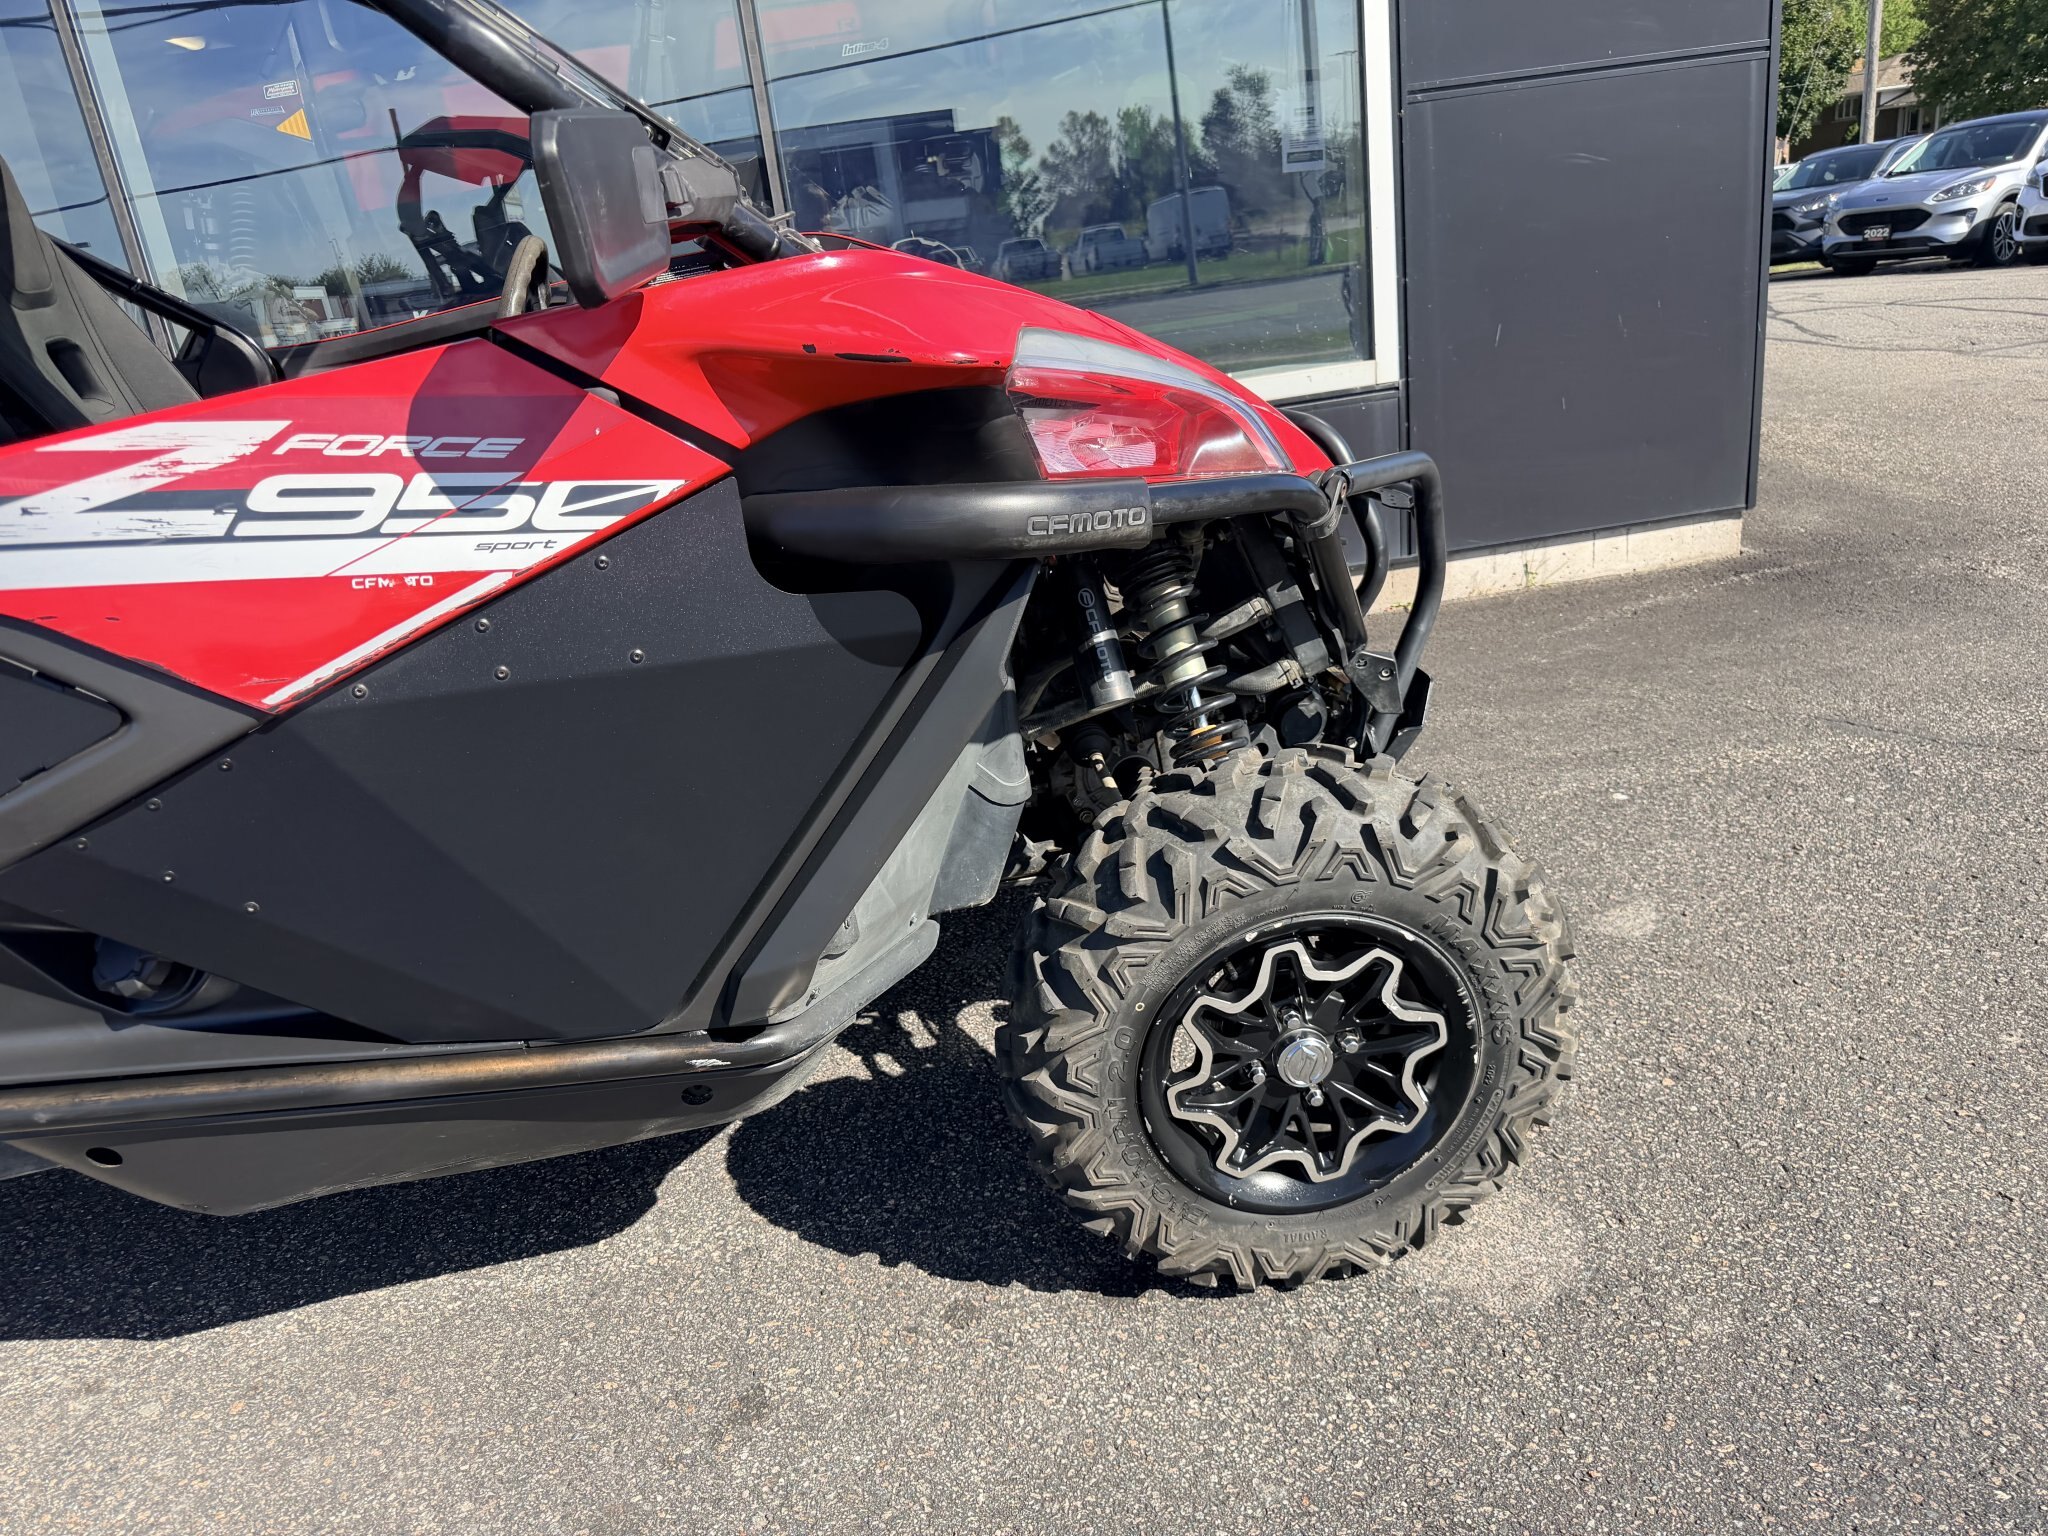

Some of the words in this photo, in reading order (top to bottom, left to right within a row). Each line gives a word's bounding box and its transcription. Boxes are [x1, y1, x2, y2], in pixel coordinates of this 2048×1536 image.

[1863, 227, 1890, 239] 2022
[272, 433, 526, 459] FORCE
[233, 471, 685, 537] 950
[1026, 506, 1147, 536] CFMOTO
[474, 538, 558, 553] sport
[351, 575, 434, 590] CFMTO
[1283, 1228, 1328, 1243] RADIAL
